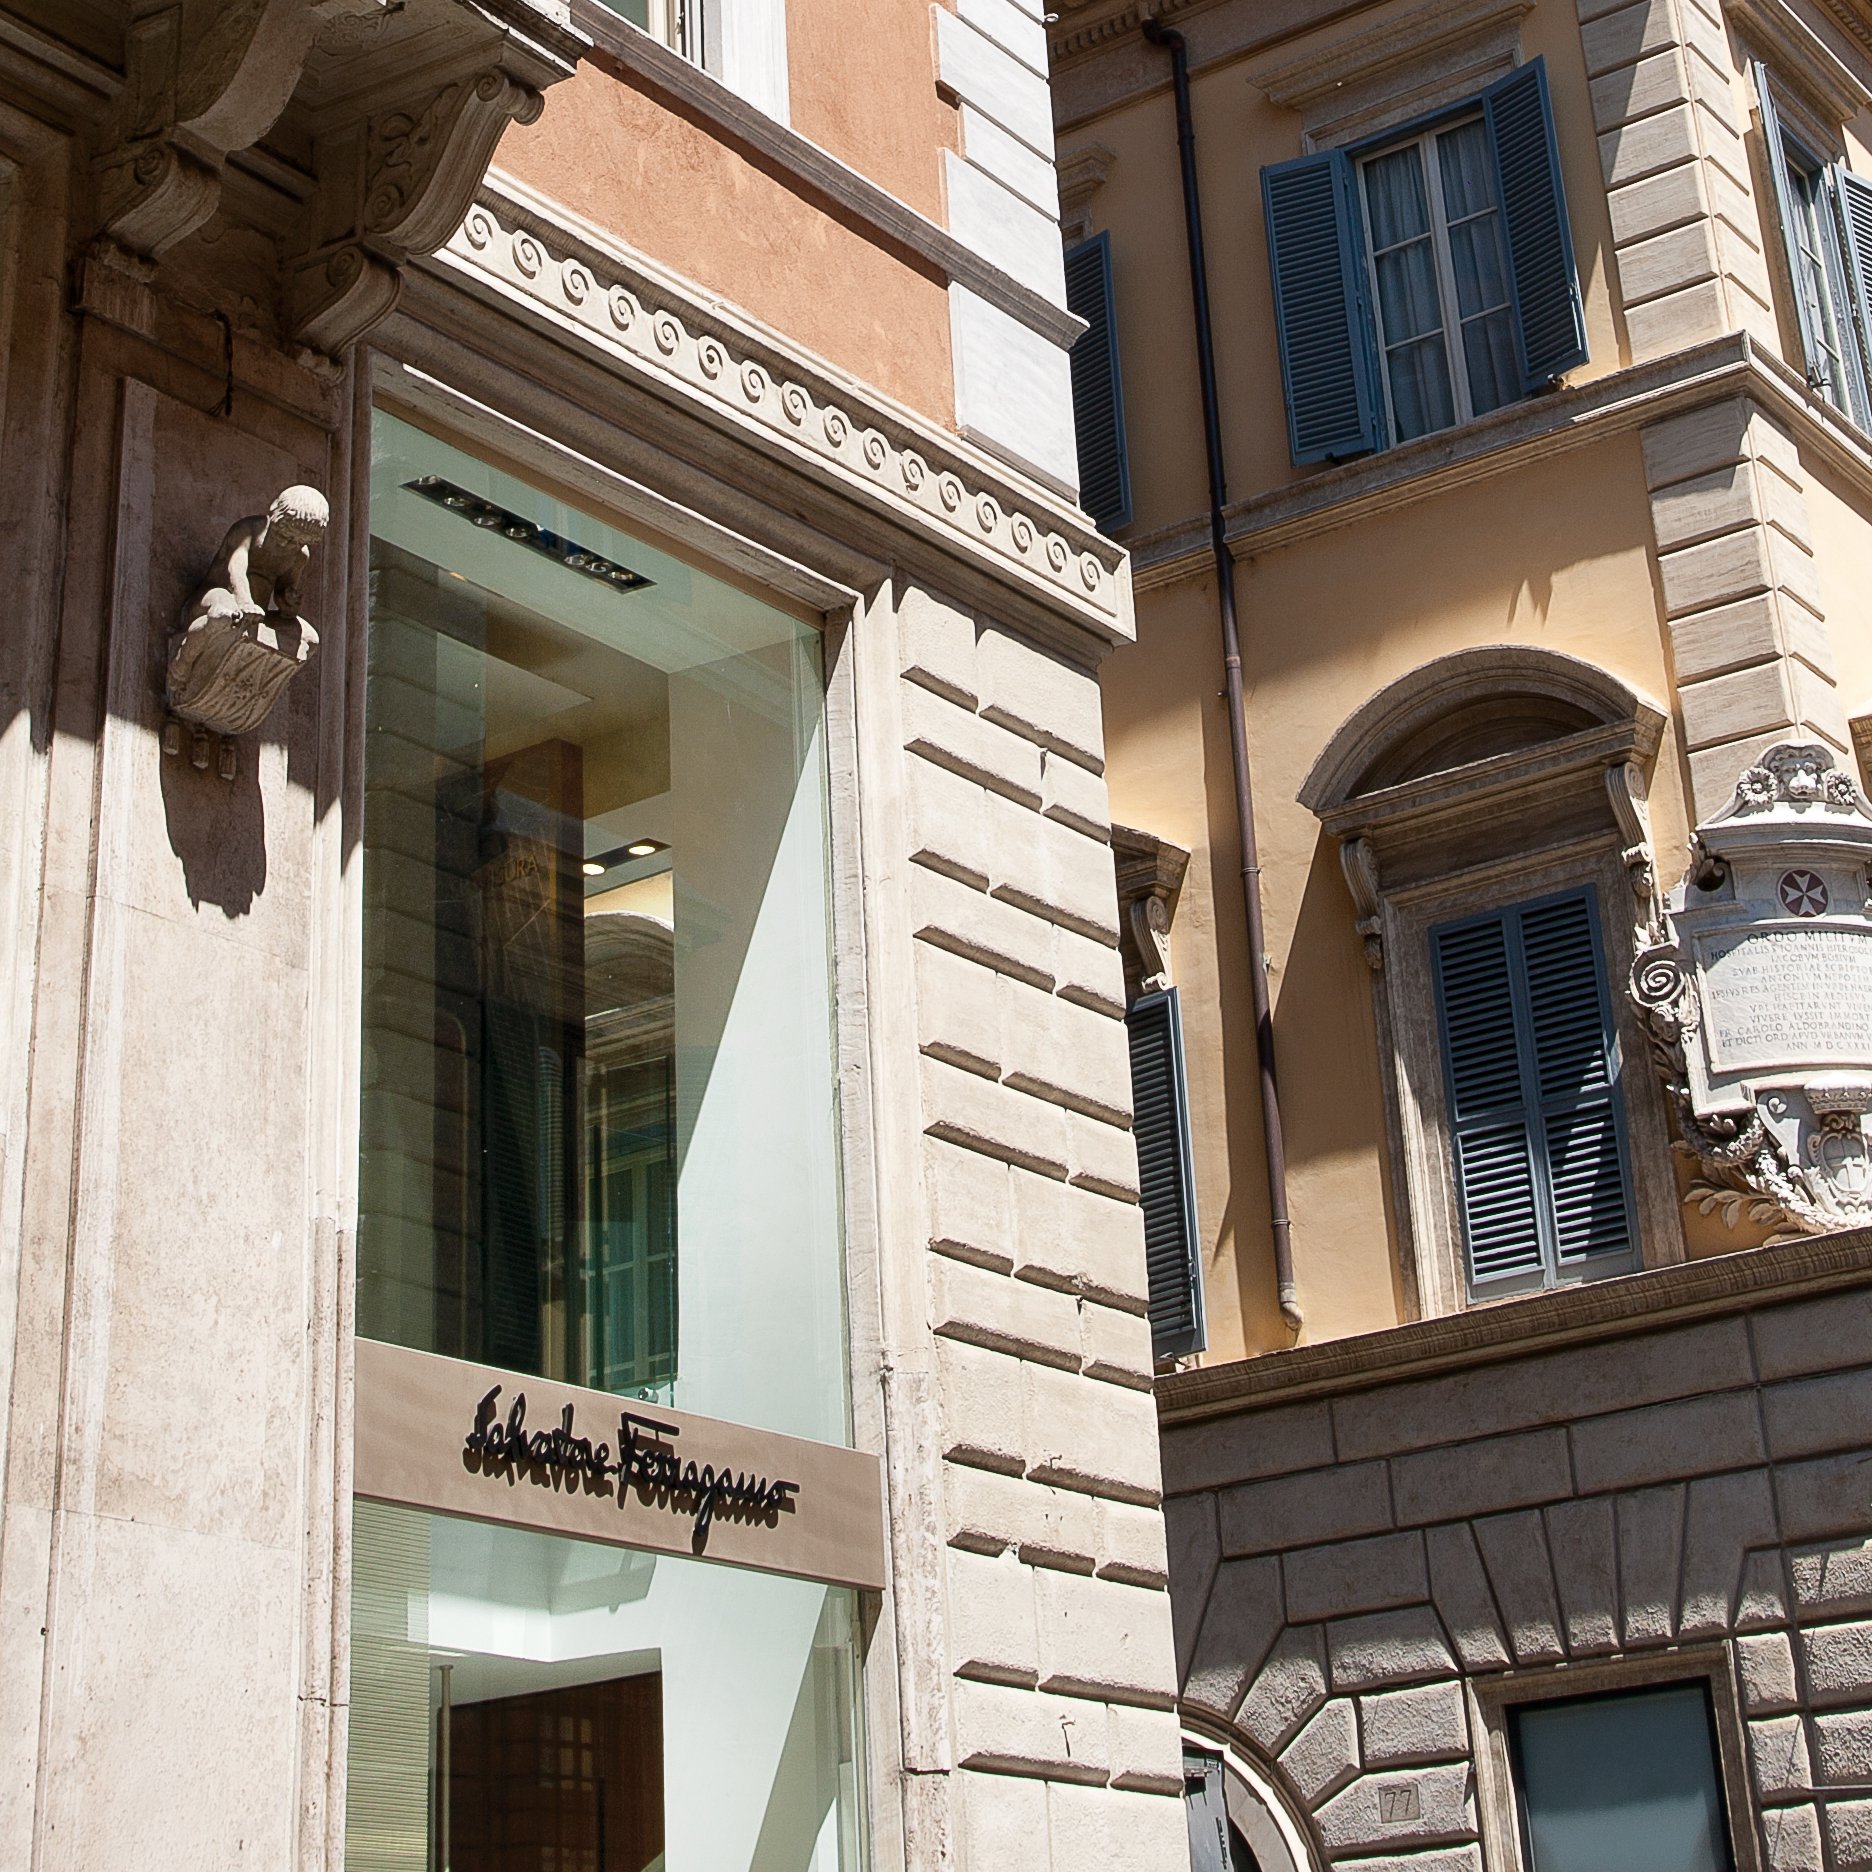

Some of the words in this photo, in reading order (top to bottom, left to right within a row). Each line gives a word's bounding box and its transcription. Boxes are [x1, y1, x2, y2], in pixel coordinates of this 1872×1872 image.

[1746, 930, 1798, 946] ORDO
[465, 1384, 618, 1476] Salvatore
[615, 1411, 800, 1537] Ferragamo
[1385, 1789, 1412, 1818] 77
